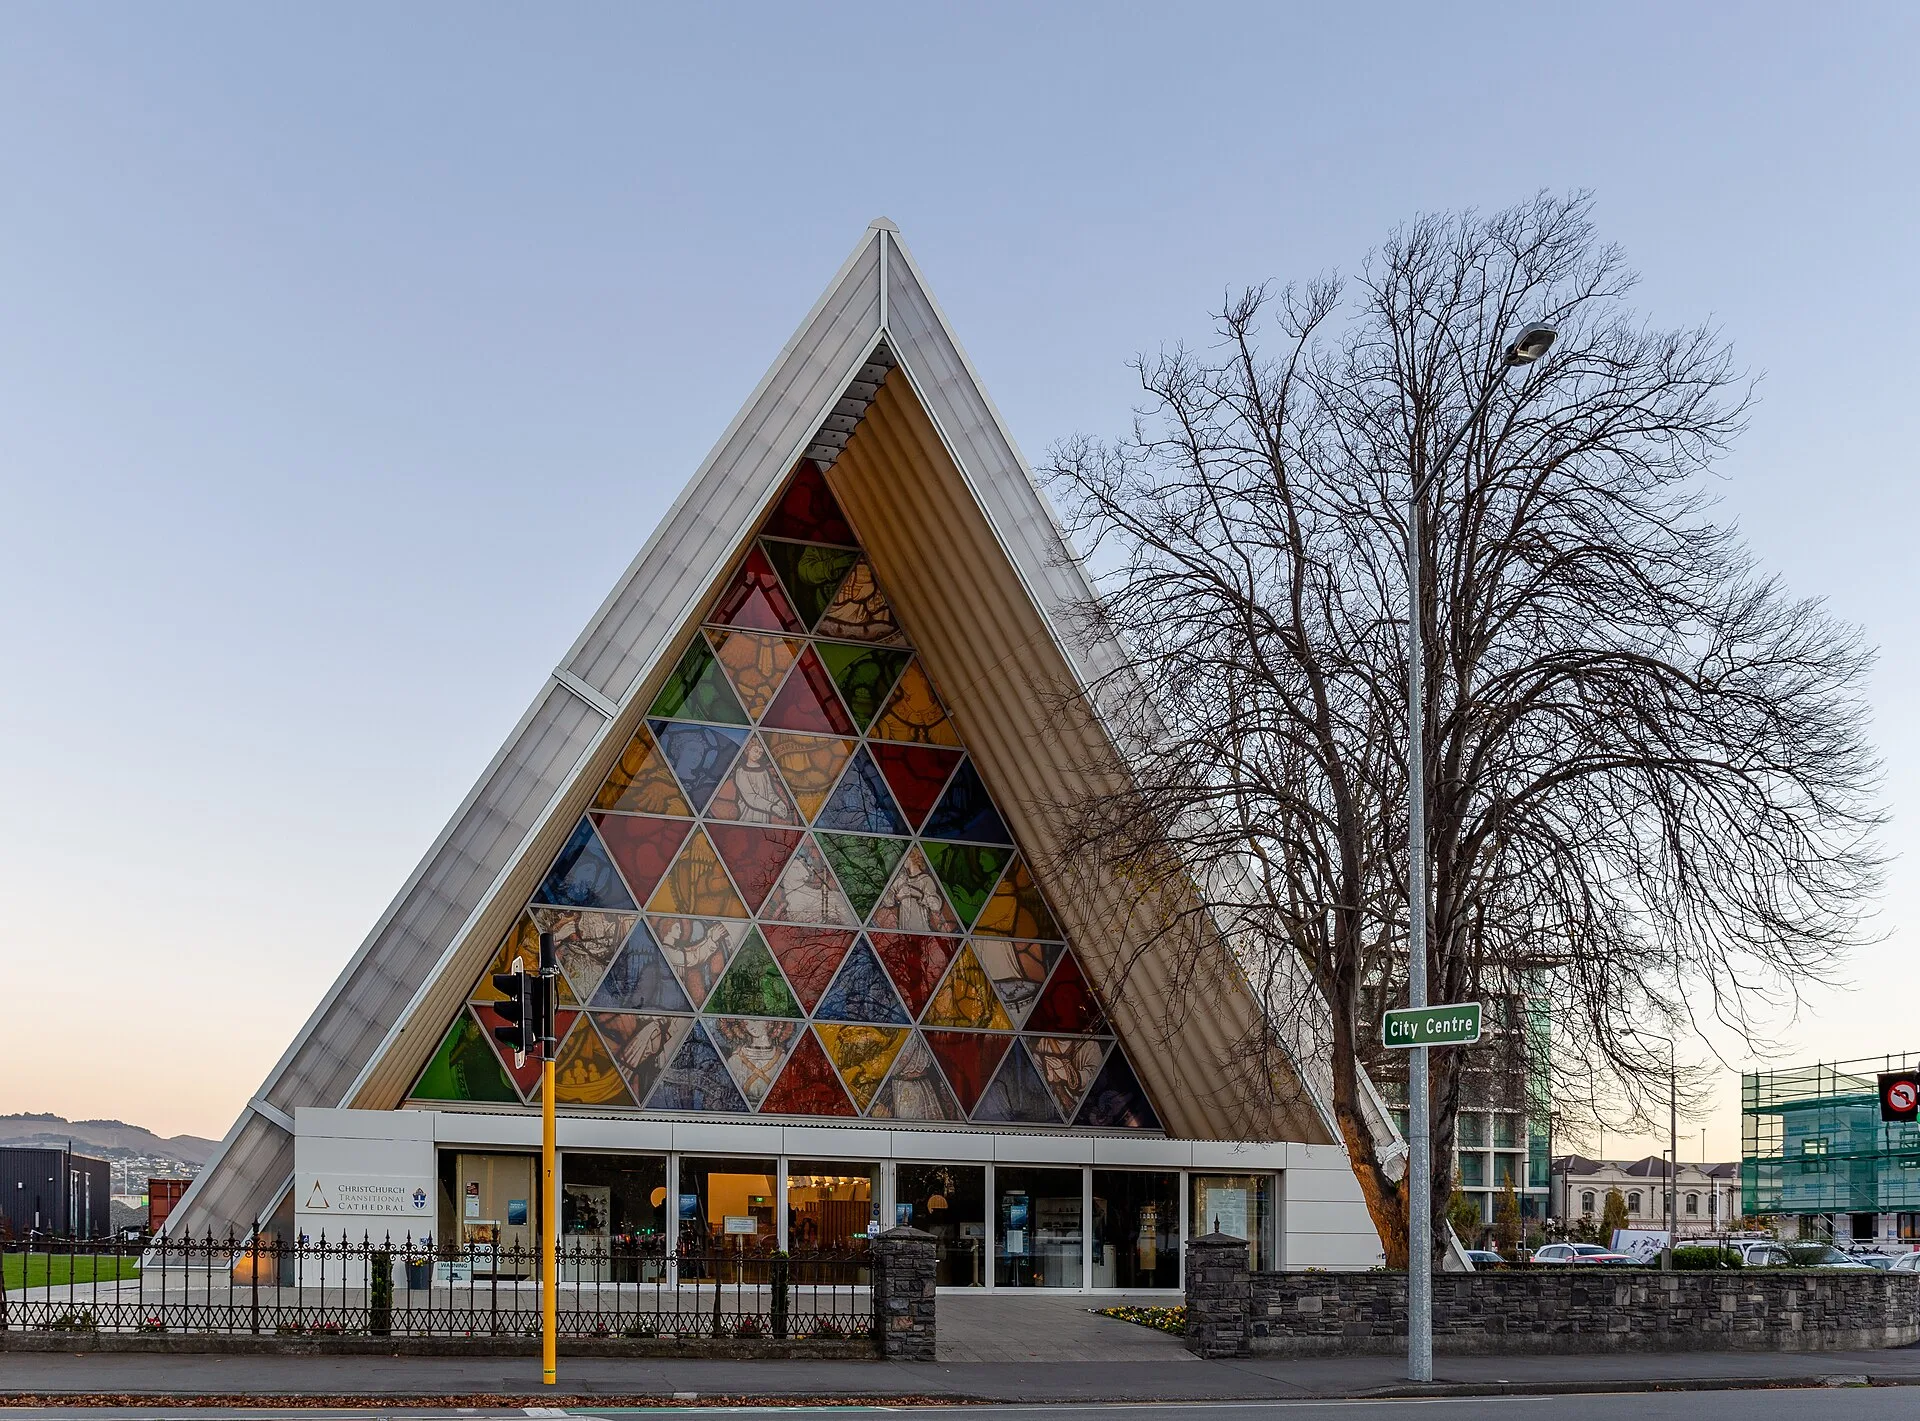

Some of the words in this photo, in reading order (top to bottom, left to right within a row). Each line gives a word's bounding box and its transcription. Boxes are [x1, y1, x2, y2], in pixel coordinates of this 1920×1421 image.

[1390, 1020, 1418, 1039] City
[1426, 1016, 1473, 1034] Centre
[338, 1193, 405, 1203] TRANSITIONAL
[338, 1202, 405, 1212] CATHEDRAL
